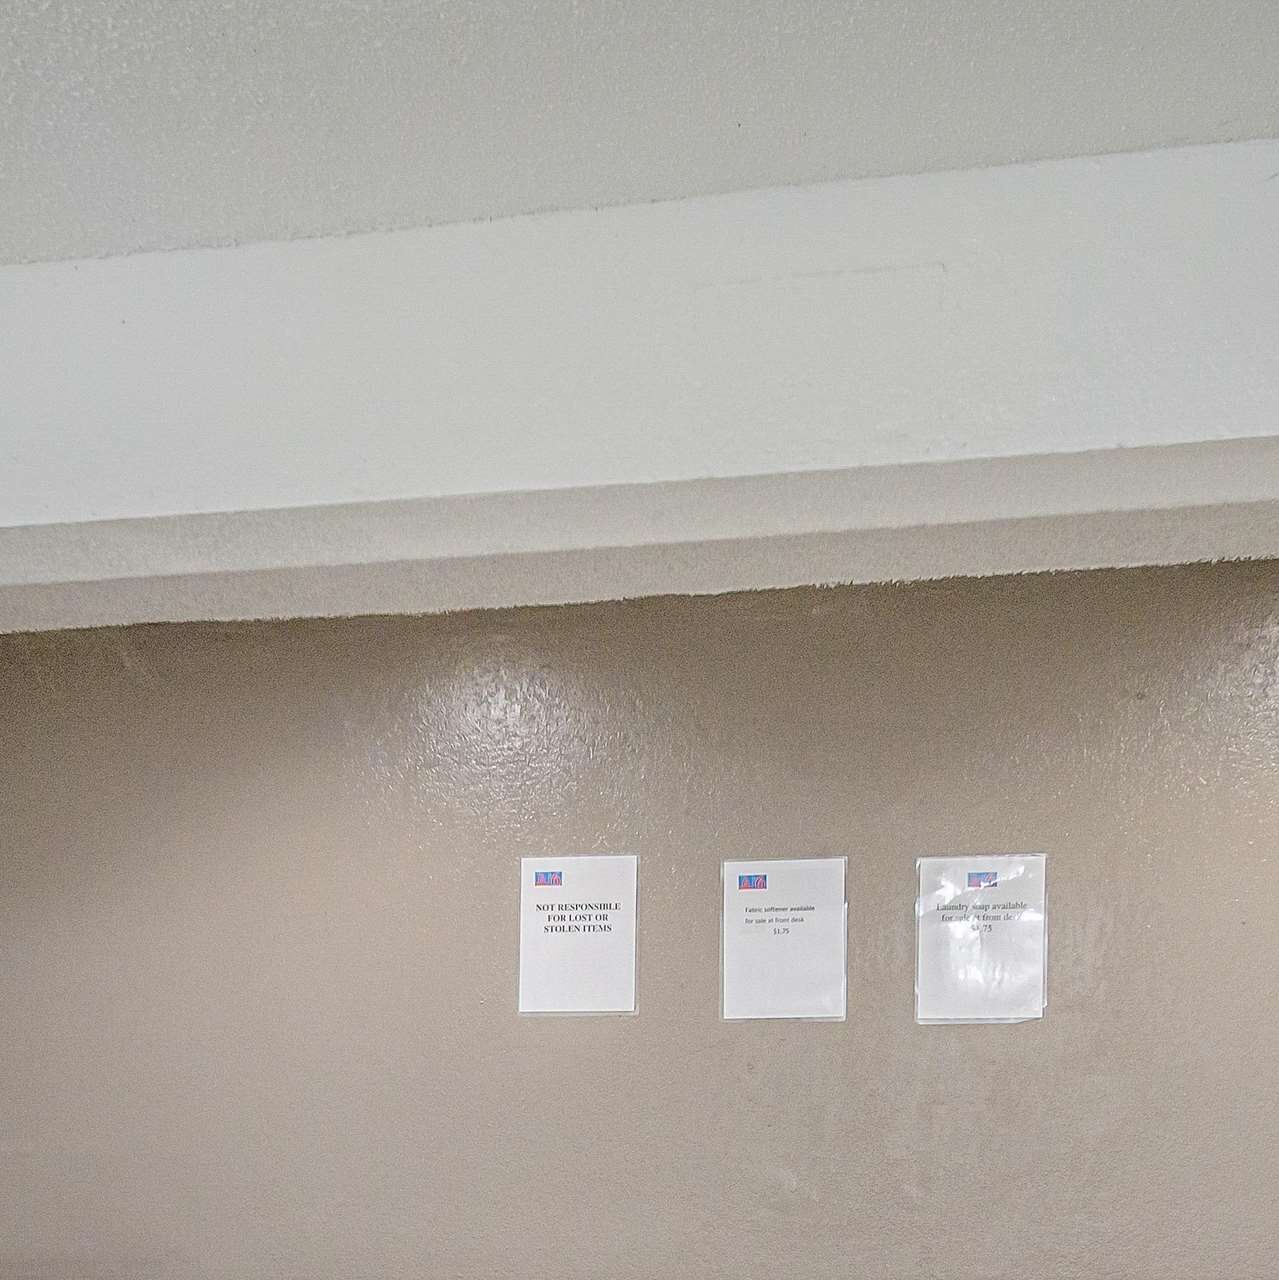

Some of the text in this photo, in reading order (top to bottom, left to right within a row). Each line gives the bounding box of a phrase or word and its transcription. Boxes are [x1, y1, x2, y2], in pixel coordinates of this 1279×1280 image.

[536, 902, 622, 912] NOT RESPONSIBLE
[936, 904, 968, 912] Laundry
[548, 913, 609, 922] FOR LOST OR
[544, 924, 612, 933] STOLEN ITEMS
